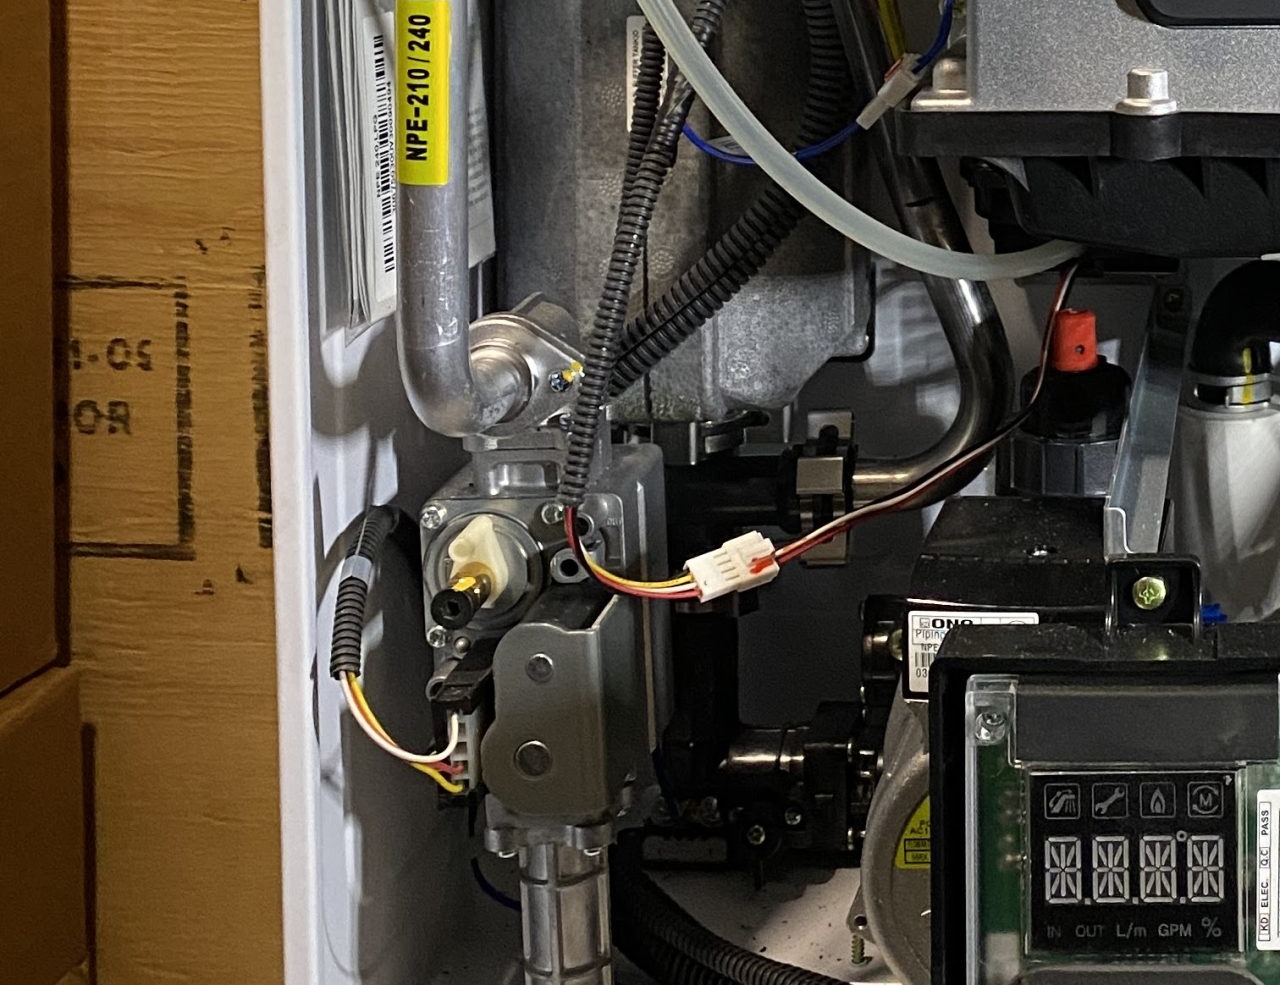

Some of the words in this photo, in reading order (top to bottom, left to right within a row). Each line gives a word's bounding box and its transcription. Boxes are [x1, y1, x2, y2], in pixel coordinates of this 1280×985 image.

[1260, 810, 1269, 836] PASS
[1047, 925, 1062, 938] IN
[1075, 925, 1104, 938] OUT
[1116, 923, 1147, 939] L/m
[1158, 924, 1192, 937] GPM
[1201, 917, 1222, 938] %
[1260, 917, 1269, 931] KD
